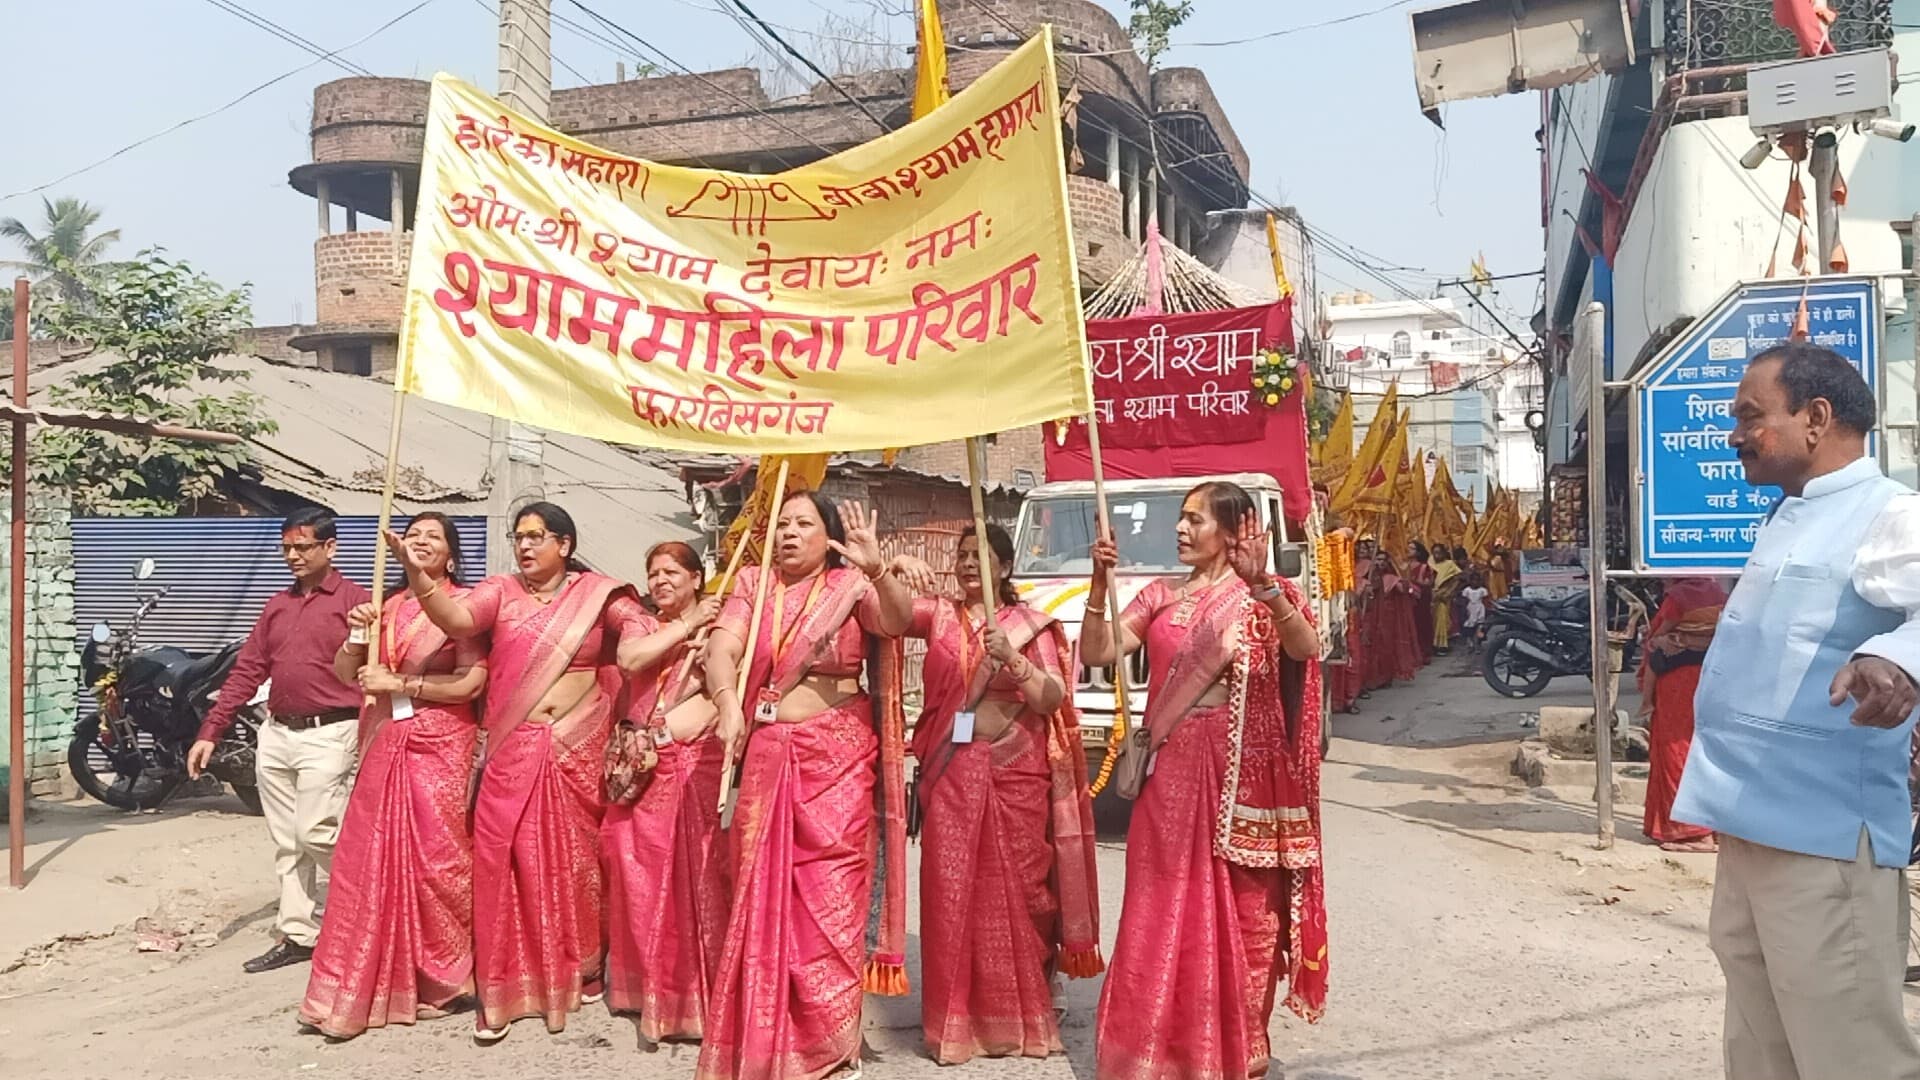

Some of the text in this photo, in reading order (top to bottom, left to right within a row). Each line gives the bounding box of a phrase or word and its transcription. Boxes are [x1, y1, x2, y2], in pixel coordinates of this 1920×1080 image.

[819, 175, 900, 209] बाबा
[533, 207, 581, 256] श्री
[588, 231, 717, 284] श्याम
[434, 250, 1043, 391] श्याम महिला परिवार
[1086, 323, 1262, 383] य श्री श्याम
[627, 384, 834, 435] फारबिसगंज
[1123, 394, 1180, 422] श्याम
[1186, 380, 1250, 417] परिवार
[1685, 393, 1736, 421] शिव
[1659, 424, 1735, 458] सांवलि
